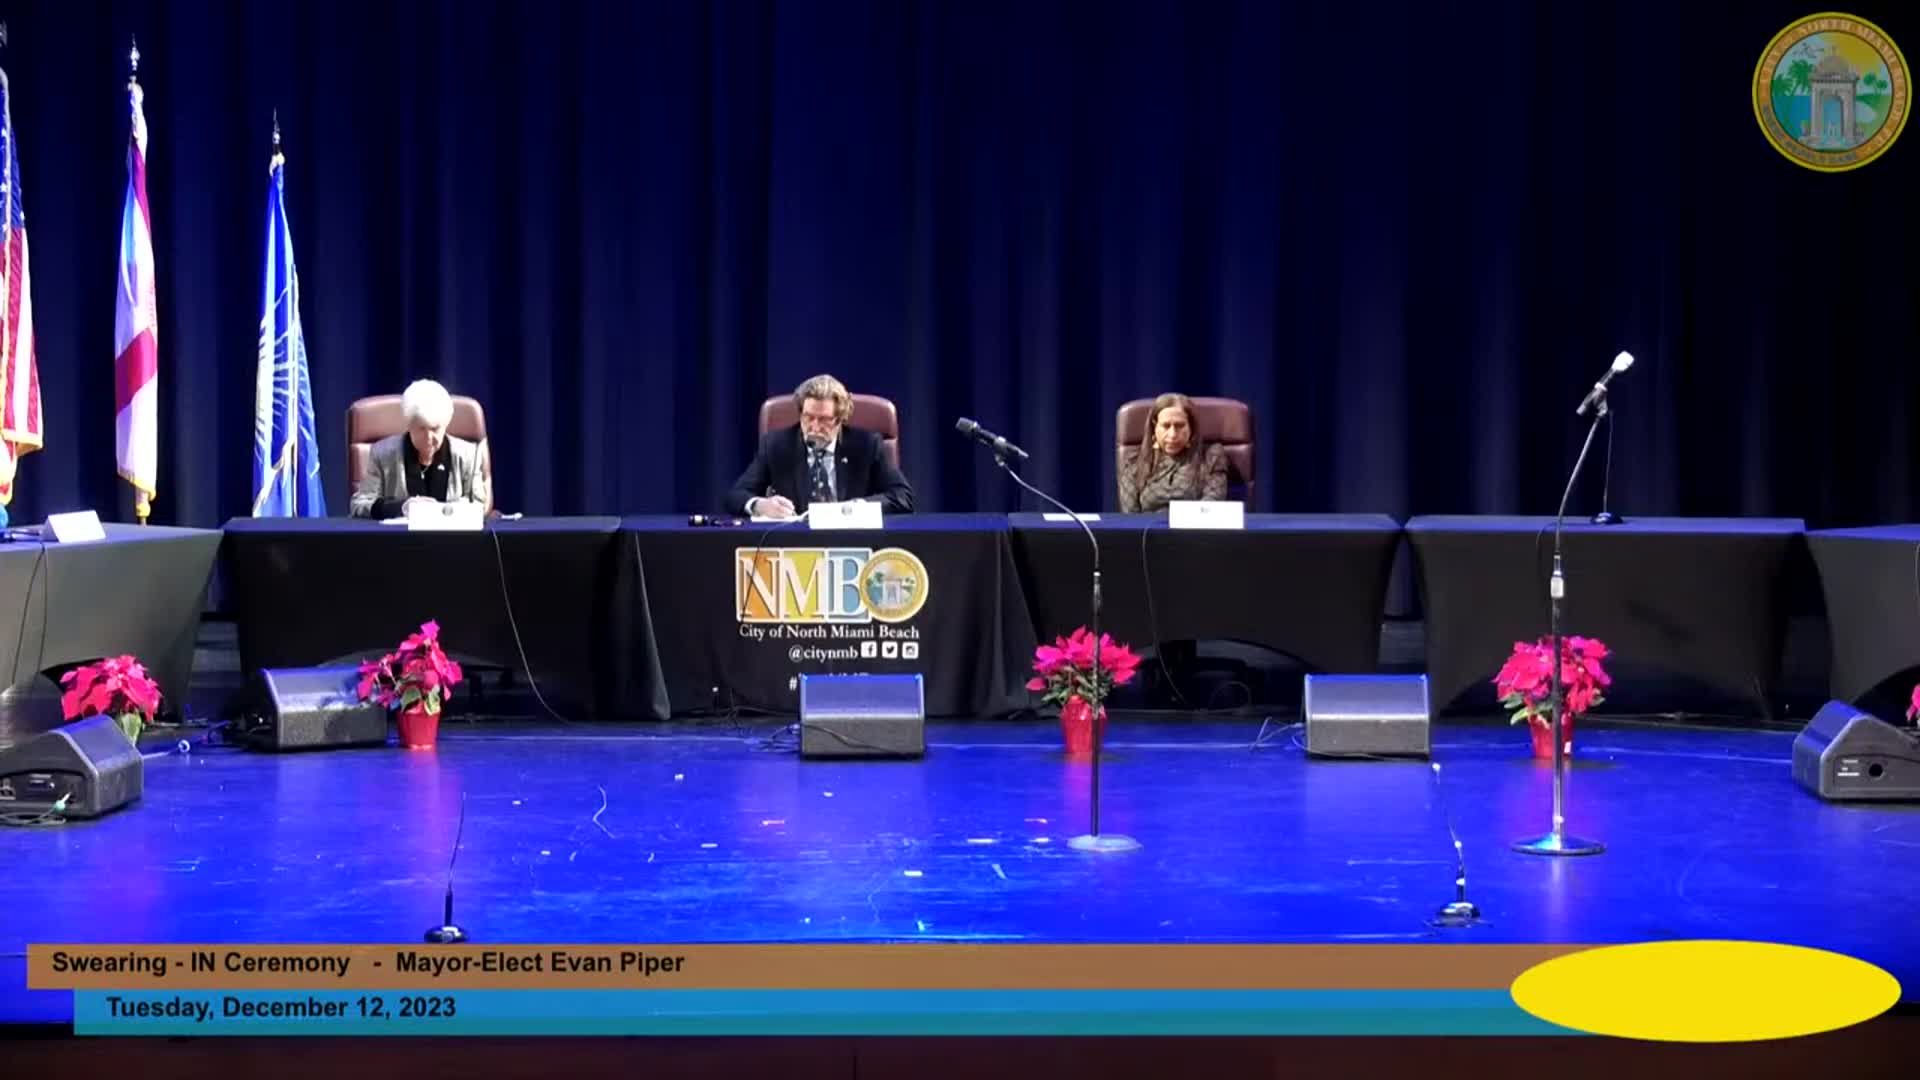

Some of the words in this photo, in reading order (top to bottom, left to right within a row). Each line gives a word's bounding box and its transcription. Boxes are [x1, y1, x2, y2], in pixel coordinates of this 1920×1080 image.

[739, 556, 864, 618] NMB
[739, 624, 765, 641] City
[769, 624, 784, 638] of
[787, 624, 827, 639] North
[831, 624, 875, 639] Miami
[880, 624, 920, 639] Beach
[789, 645, 859, 663] @citynmb
